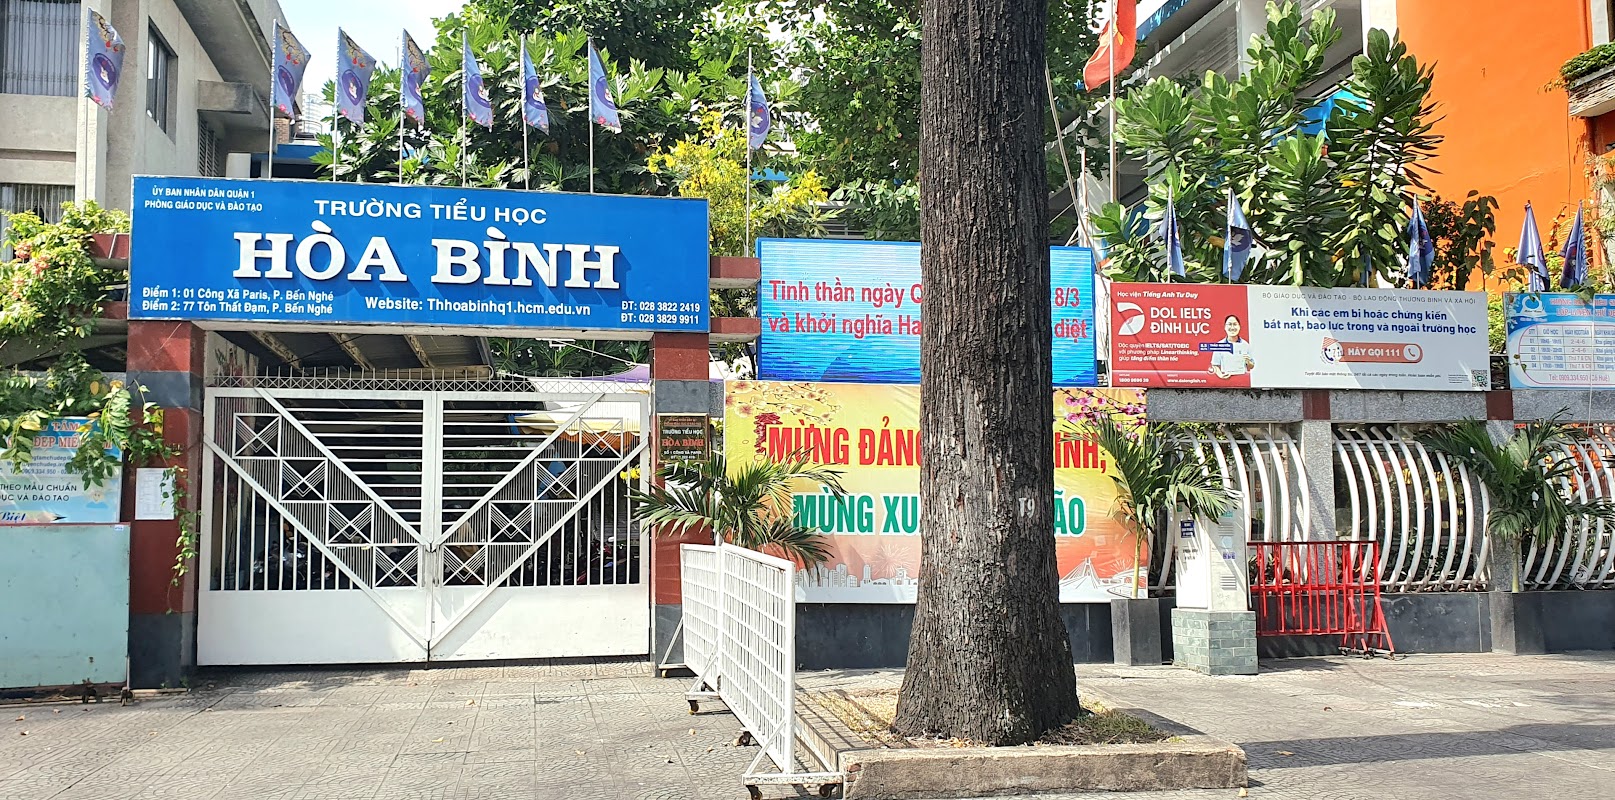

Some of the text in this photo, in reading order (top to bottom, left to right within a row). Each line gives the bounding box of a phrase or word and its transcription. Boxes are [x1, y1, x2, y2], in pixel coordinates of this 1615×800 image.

[152, 185, 163, 196] ỦY
[165, 188, 182, 196] BAN
[183, 187, 206, 197] NHÂN
[208, 188, 224, 198] DÂN
[226, 189, 249, 199] QUẬN
[144, 199, 263, 212] PHÒNG GIÁO DỤC VÀ ĐÀO TẠO
[314, 197, 547, 226] TRƯỜNG TIỂU HỌC
[233, 219, 620, 289] HÒA BÌNH
[142, 285, 334, 303] Điểm 1: 01 Công Xã Paris, P. Bến Nghé
[769, 280, 808, 302] Tinh
[815, 277, 854, 303] thần
[861, 282, 904, 309] ngày
[1054, 286, 1080, 307] 8/3
[142, 299, 333, 317] Điểm 2: 77 Tôn Thất Đạm, P. Bến Nghé
[365, 297, 591, 316] Website: Thhoabinhq1.hcm.edu.vn
[621, 301, 700, 312] ĐT: 028 3822 2419
[1150, 306, 1211, 319] DOL IELTS
[1291, 307, 1309, 316] Khi
[1311, 308, 1330, 317] các
[1352, 309, 1361, 320] bị
[1364, 309, 1389, 320] hoặc
[1392, 310, 1423, 321] chứng
[1425, 311, 1447, 320] kiến
[621, 313, 699, 325] ĐT: 028 3829 9911
[1263, 319, 1281, 329] bắt
[1307, 320, 1326, 332] bạo
[1328, 321, 1345, 332] lực
[1347, 322, 1374, 332] trong
[1377, 323, 1389, 331] và
[1391, 323, 1420, 333] ngoài
[1422, 323, 1455, 335] trường
[1457, 325, 1476, 335] học
[768, 315, 790, 333] và
[795, 312, 836, 333] khởi
[842, 314, 892, 339] nghĩa
[1054, 317, 1087, 343] diệt
[1150, 320, 1210, 336] ĐÌNH LỰC
[1348, 347, 1400, 358] HÃY GỌI 111
[662, 436, 704, 447] HÒA BÌNH
[768, 419, 849, 466] MỪNG
[858, 416, 921, 466] ĐẢN
[0, 483, 21, 491] THEO
